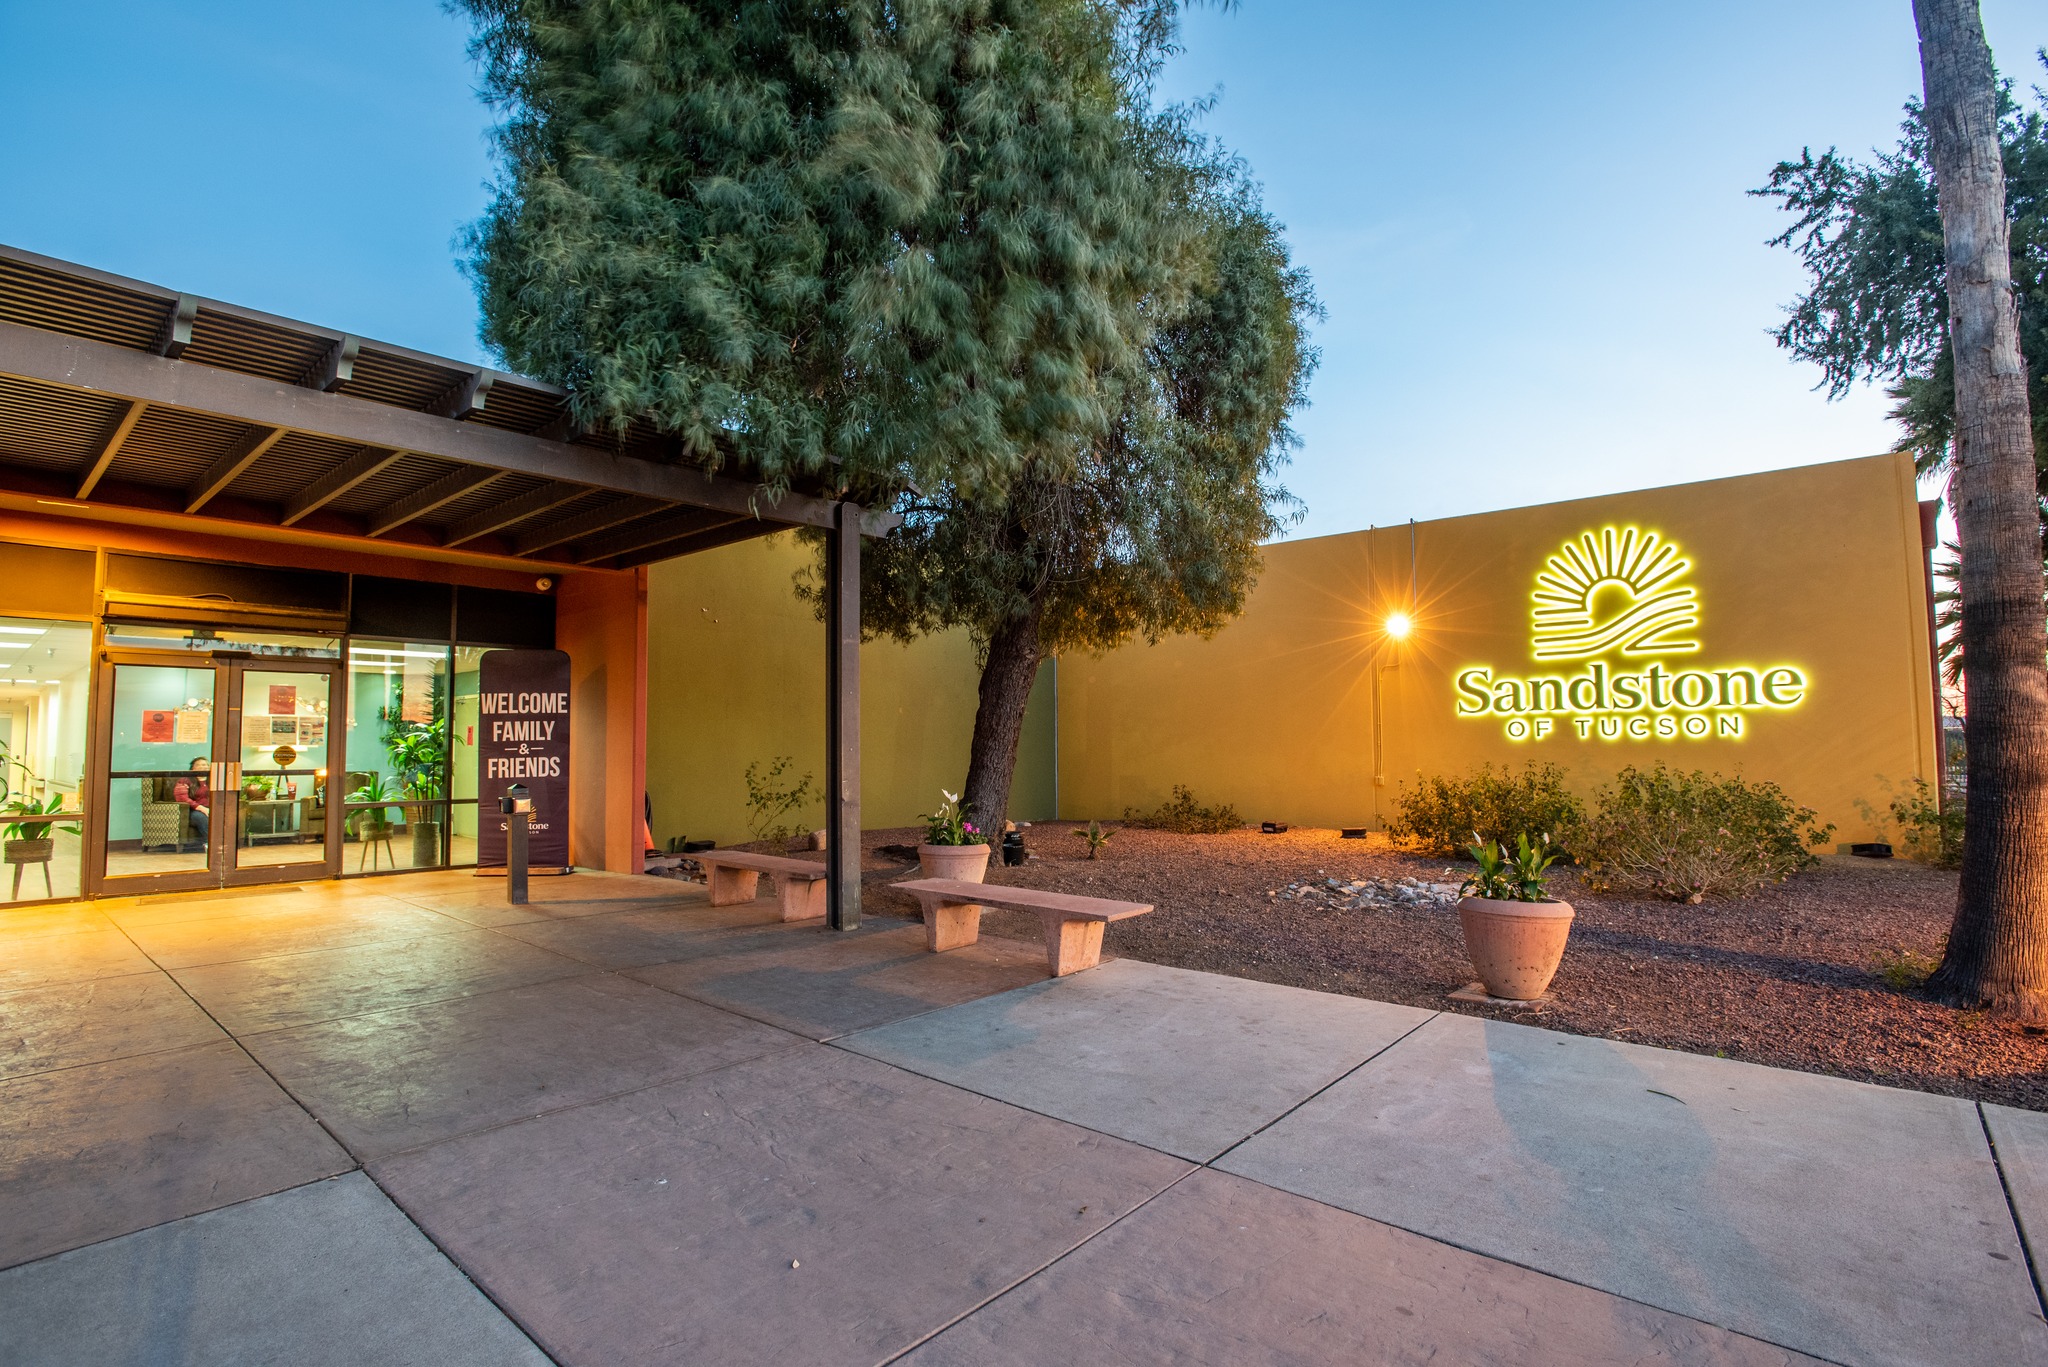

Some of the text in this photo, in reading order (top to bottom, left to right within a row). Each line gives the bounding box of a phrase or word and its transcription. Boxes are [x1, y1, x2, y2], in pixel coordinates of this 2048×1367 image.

[1458, 664, 1803, 714] Sandstone
[481, 692, 568, 714] WELCOME
[493, 720, 556, 742] FAMILY
[1507, 716, 1740, 738] OF TUCSON
[518, 743, 530, 755] &
[488, 756, 561, 779] FRIENDS
